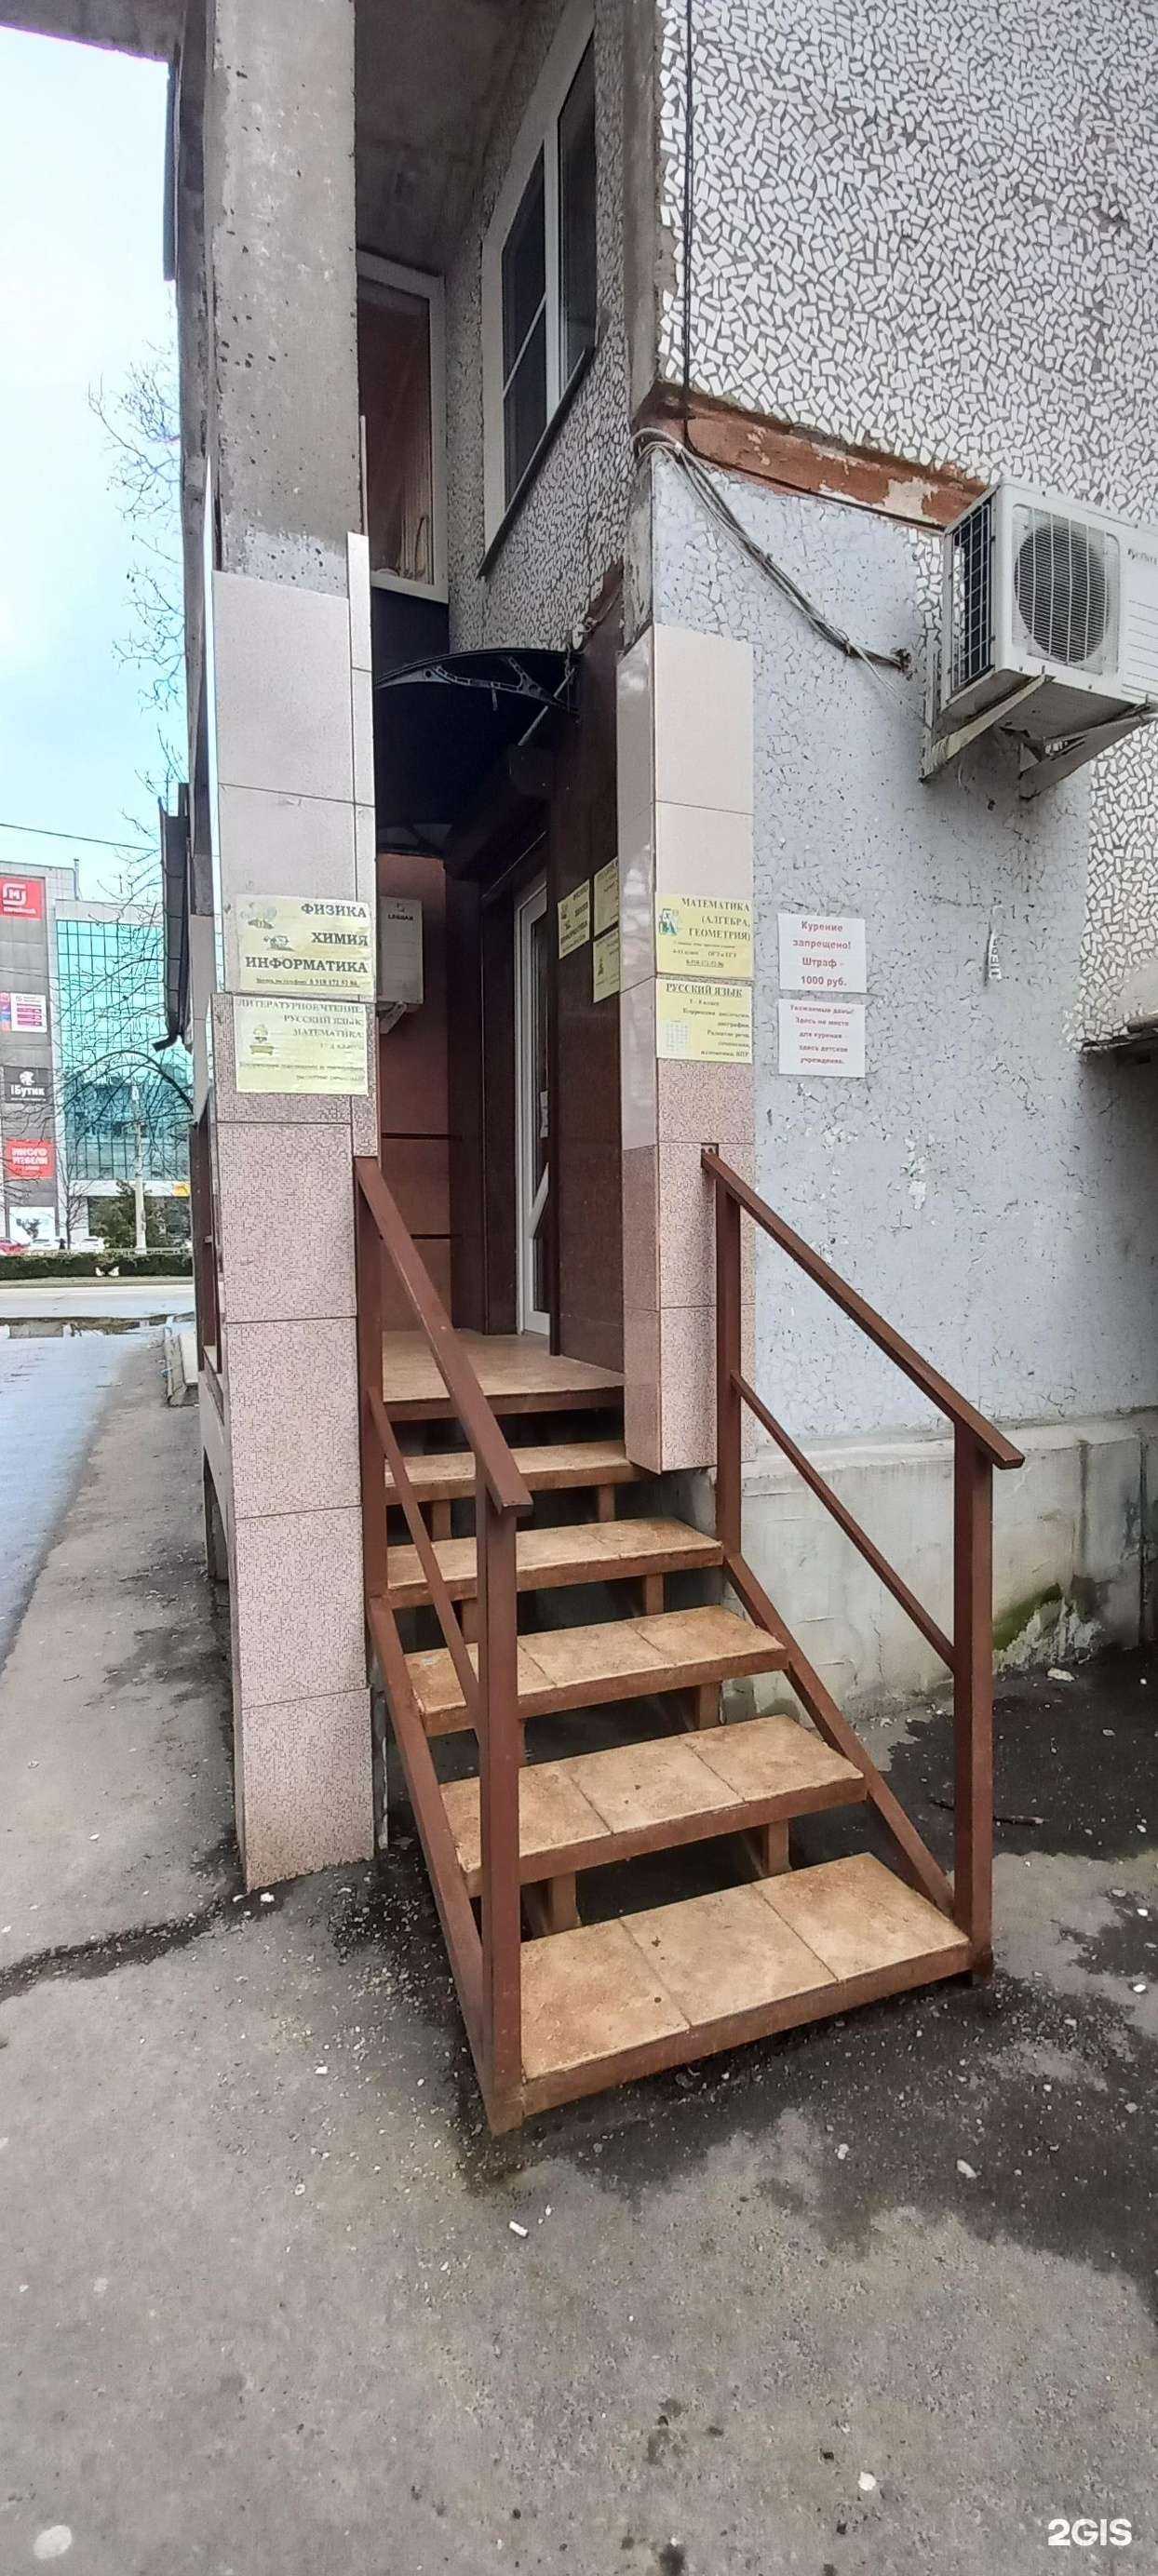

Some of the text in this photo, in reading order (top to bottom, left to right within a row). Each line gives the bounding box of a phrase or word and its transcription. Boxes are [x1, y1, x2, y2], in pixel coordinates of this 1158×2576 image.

[301, 903, 367, 918] ФИЗИКА
[681, 898, 750, 912] МАТЕМАТИКА
[801, 920, 843, 932] Курение
[311, 932, 369, 946] ХИМИЯ
[792, 939, 851, 950] запрещено!
[245, 957, 369, 973] ИНФОРМАТИКА
[802, 957, 837, 969] Штраф
[801, 975, 847, 987] 1000 руб.
[666, 983, 743, 999] РУССКИЙ ЯЗЫК
[239, 999, 319, 1012] ЛИТЕРАТУРНОЕ
[283, 1014, 331, 1025] РУССКИЙ
